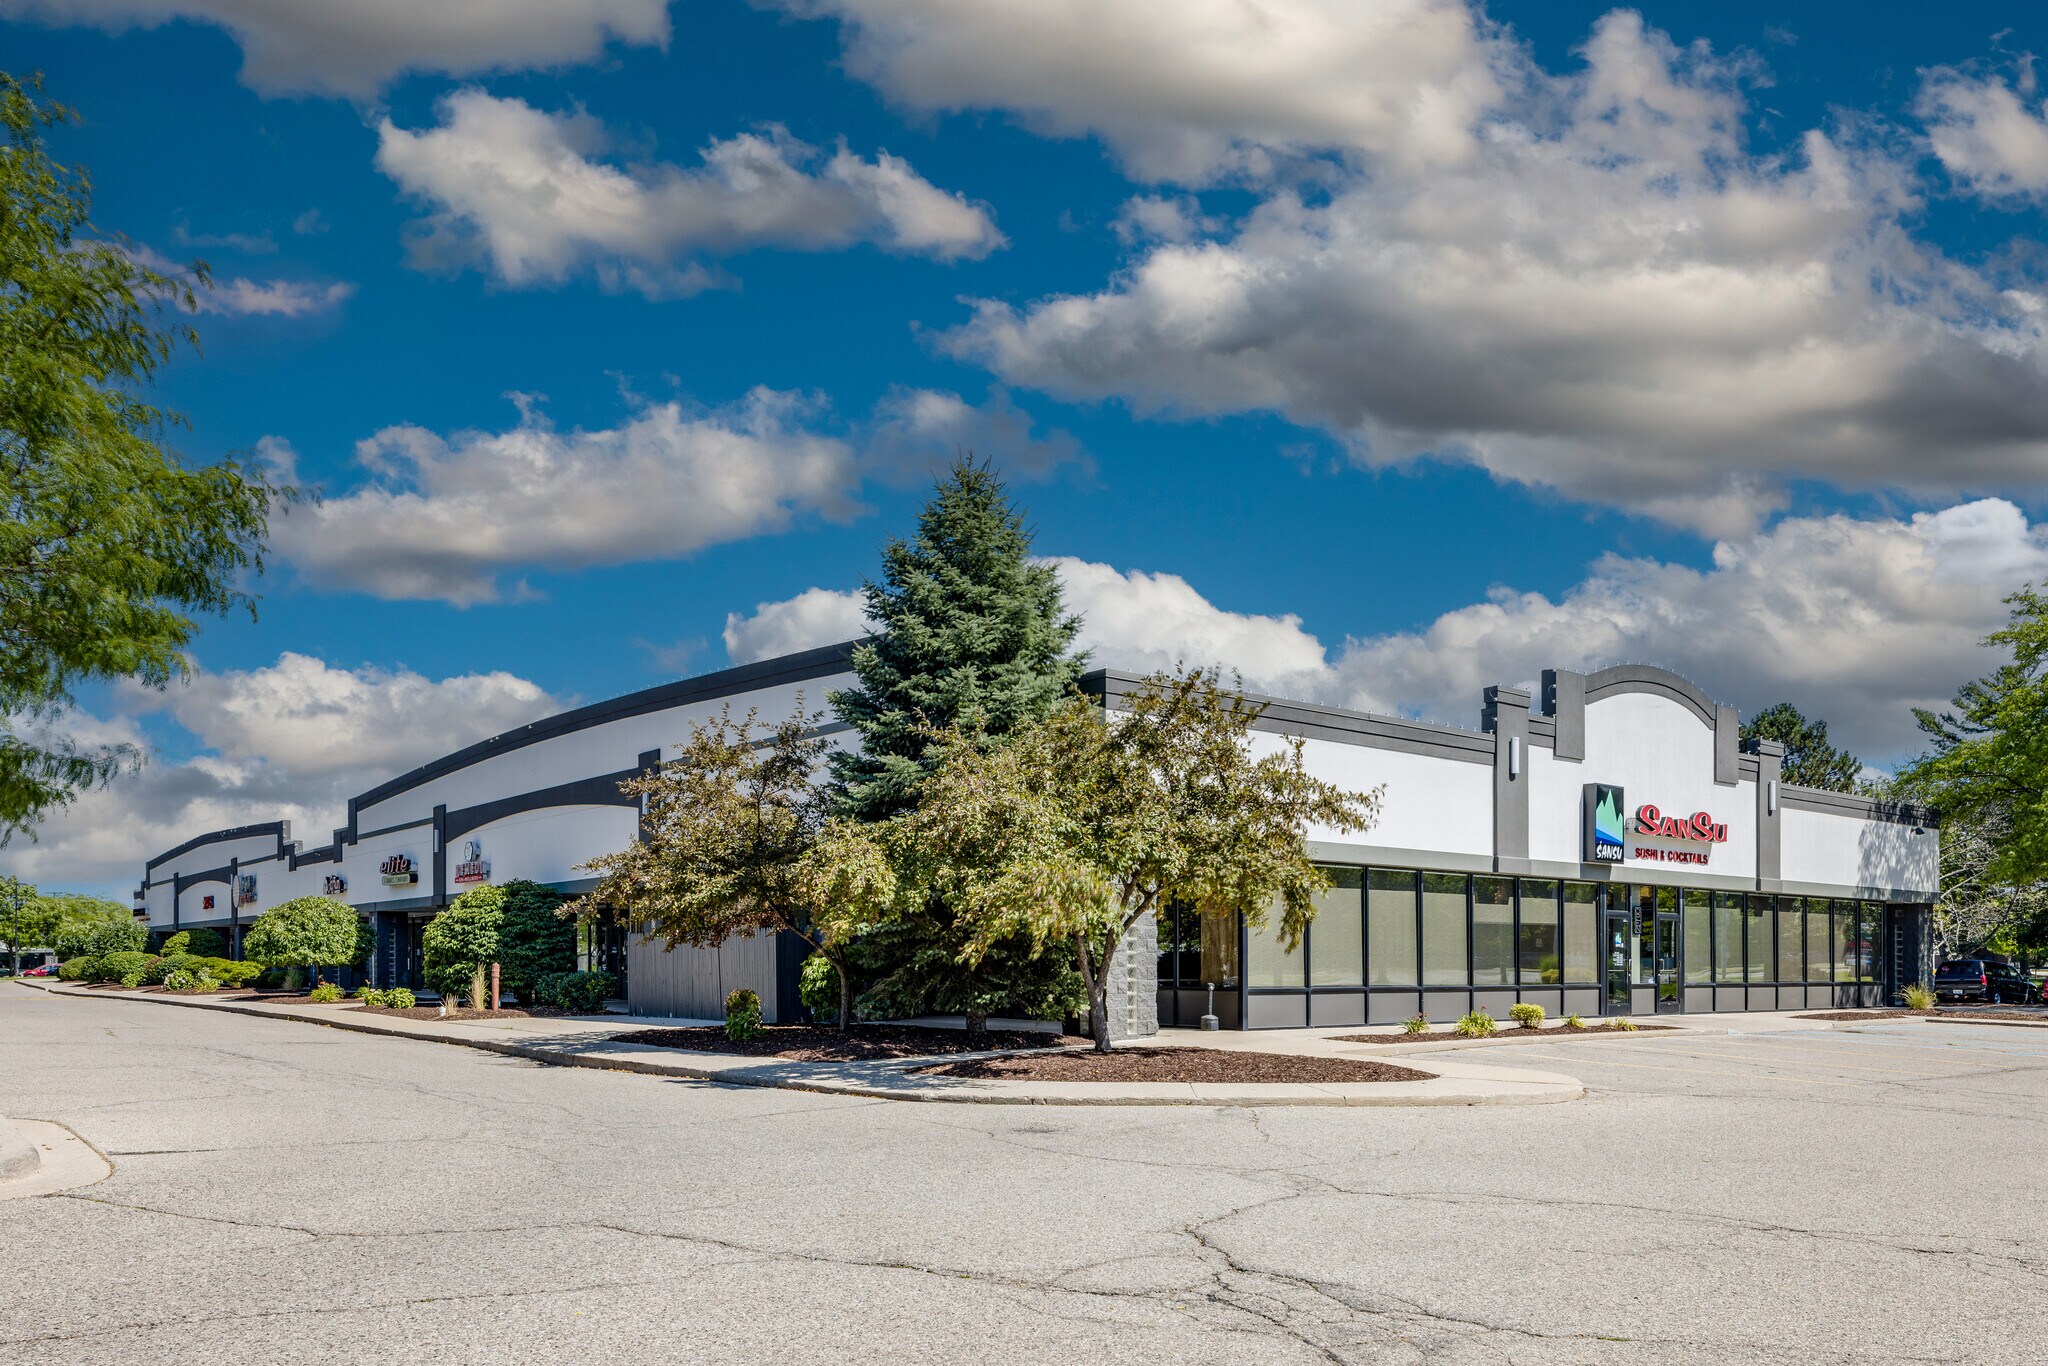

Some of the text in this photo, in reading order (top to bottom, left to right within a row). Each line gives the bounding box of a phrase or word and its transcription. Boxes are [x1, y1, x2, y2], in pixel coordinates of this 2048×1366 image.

[380, 855, 409, 874] elite
[1635, 848, 1708, 865] SUSHI & COCKTAILS
